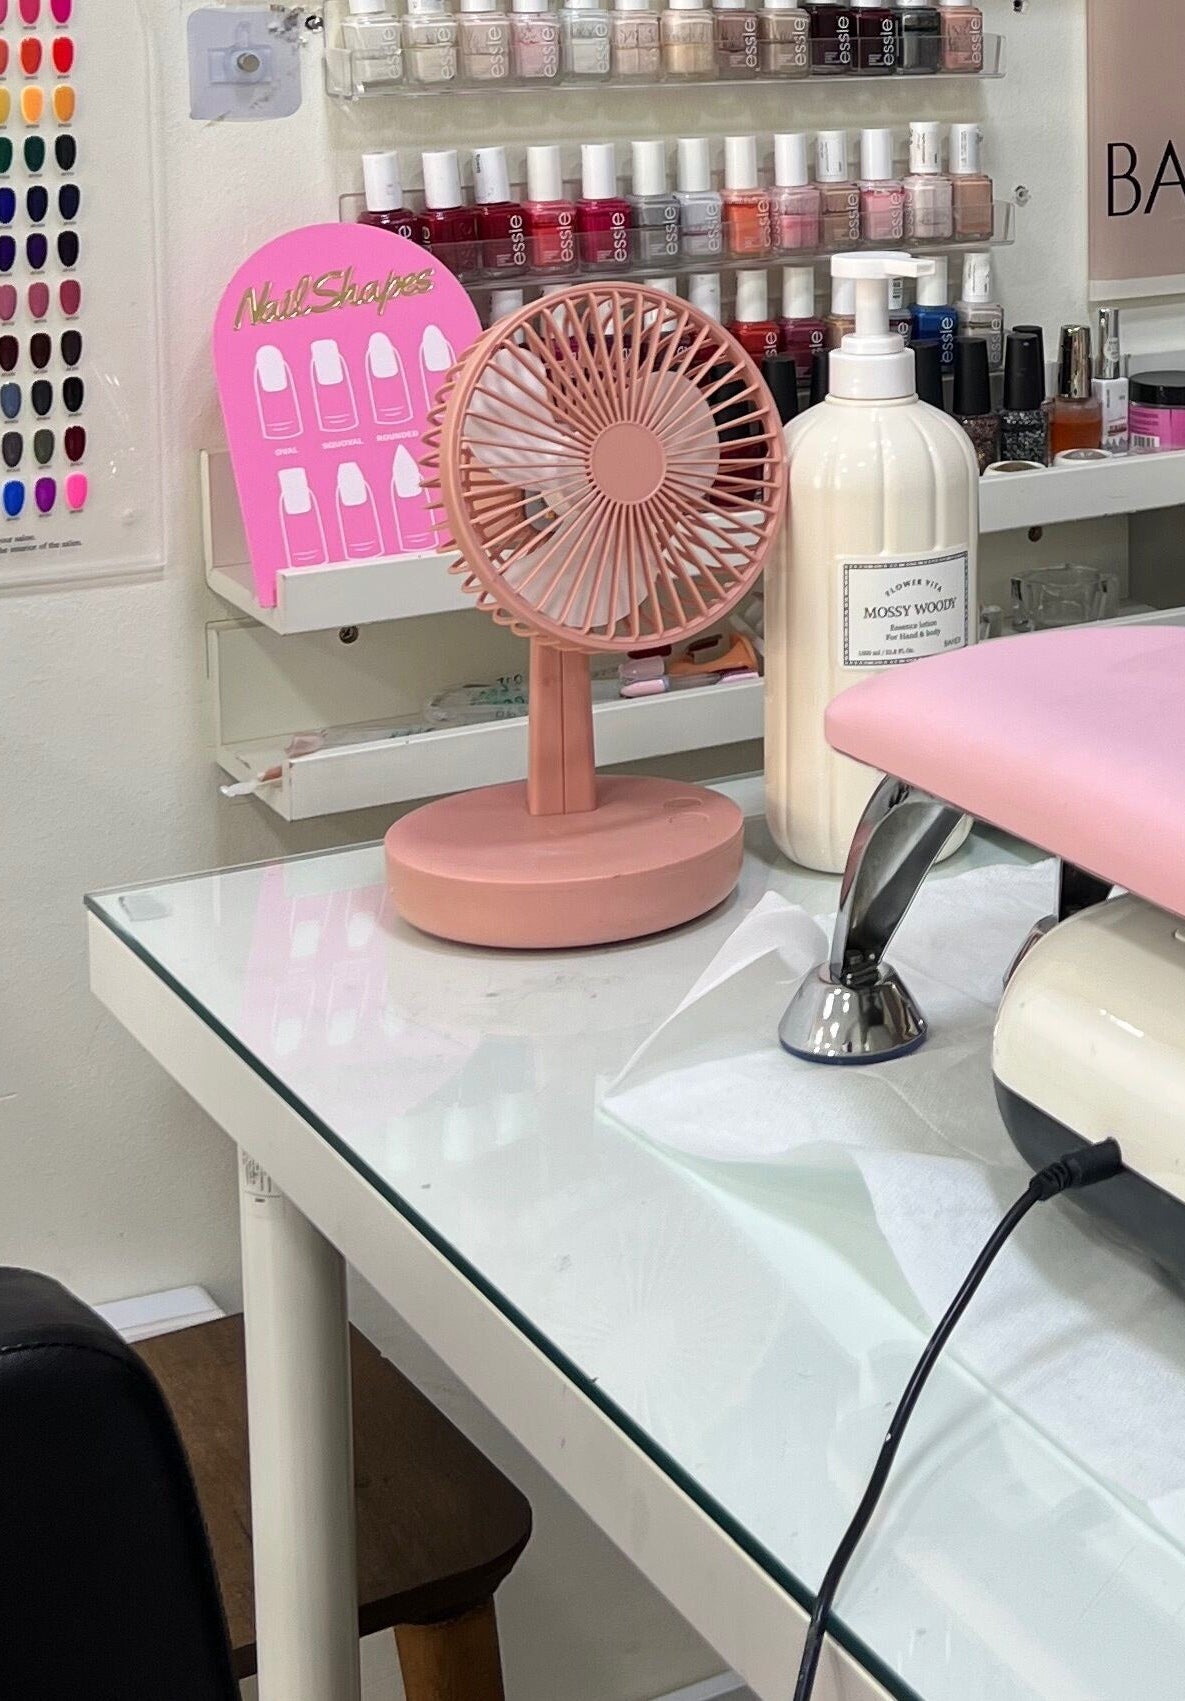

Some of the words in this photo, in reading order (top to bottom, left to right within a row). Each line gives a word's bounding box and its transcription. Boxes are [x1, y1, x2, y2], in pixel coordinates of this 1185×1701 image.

[488, 25, 505, 79] essie
[542, 26, 557, 79] essie
[743, 18, 758, 68] essie
[792, 16, 807, 67] essie
[836, 15, 851, 65] essie
[880, 17, 895, 67] essie
[968, 17, 982, 65] essie
[508, 214, 527, 266] essie
[557, 211, 575, 263] essie
[610, 211, 628, 263] essie
[662, 205, 679, 256] essie
[705, 203, 721, 251] essie
[847, 194, 861, 240] essie
[890, 193, 904, 240] essie
[234, 275, 312, 331] Nail
[312, 266, 436, 316] Shapes
[940, 316, 954, 364] essie
[376, 430, 419, 442] ROUNDED
[863, 604, 912, 619] MOSSY
[914, 597, 957, 616] WOODY
[885, 578, 923, 597] FLOWER
[925, 579, 943, 593] VITA
[886, 633, 898, 641] For
[899, 631, 918, 640] Hand
[890, 622, 918, 632] Essence
